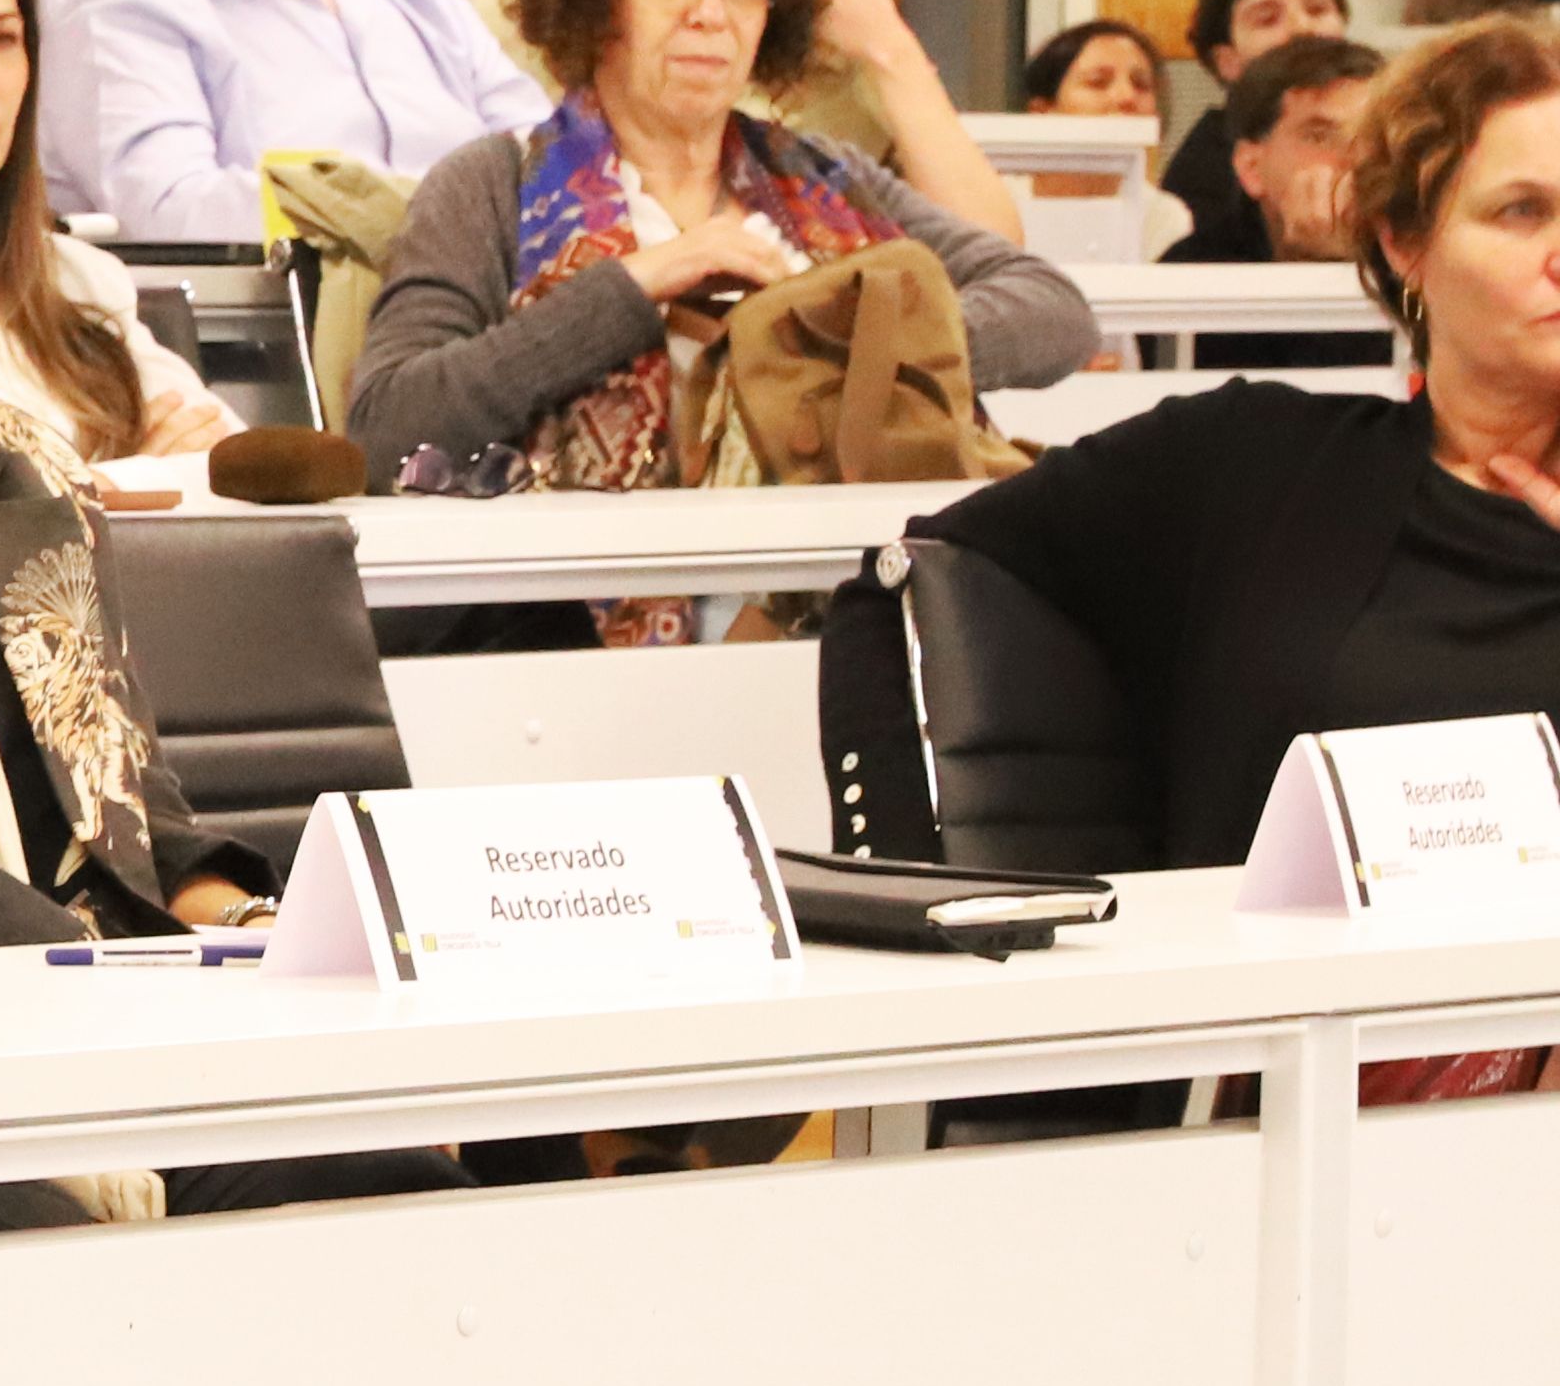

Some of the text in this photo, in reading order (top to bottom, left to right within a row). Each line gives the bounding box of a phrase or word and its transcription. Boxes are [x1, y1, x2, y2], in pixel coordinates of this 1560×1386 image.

[1402, 773, 1486, 807] Reservado
[1408, 816, 1503, 850] Autoridades
[485, 840, 625, 873] Reservado
[490, 887, 652, 921] Autoridades
